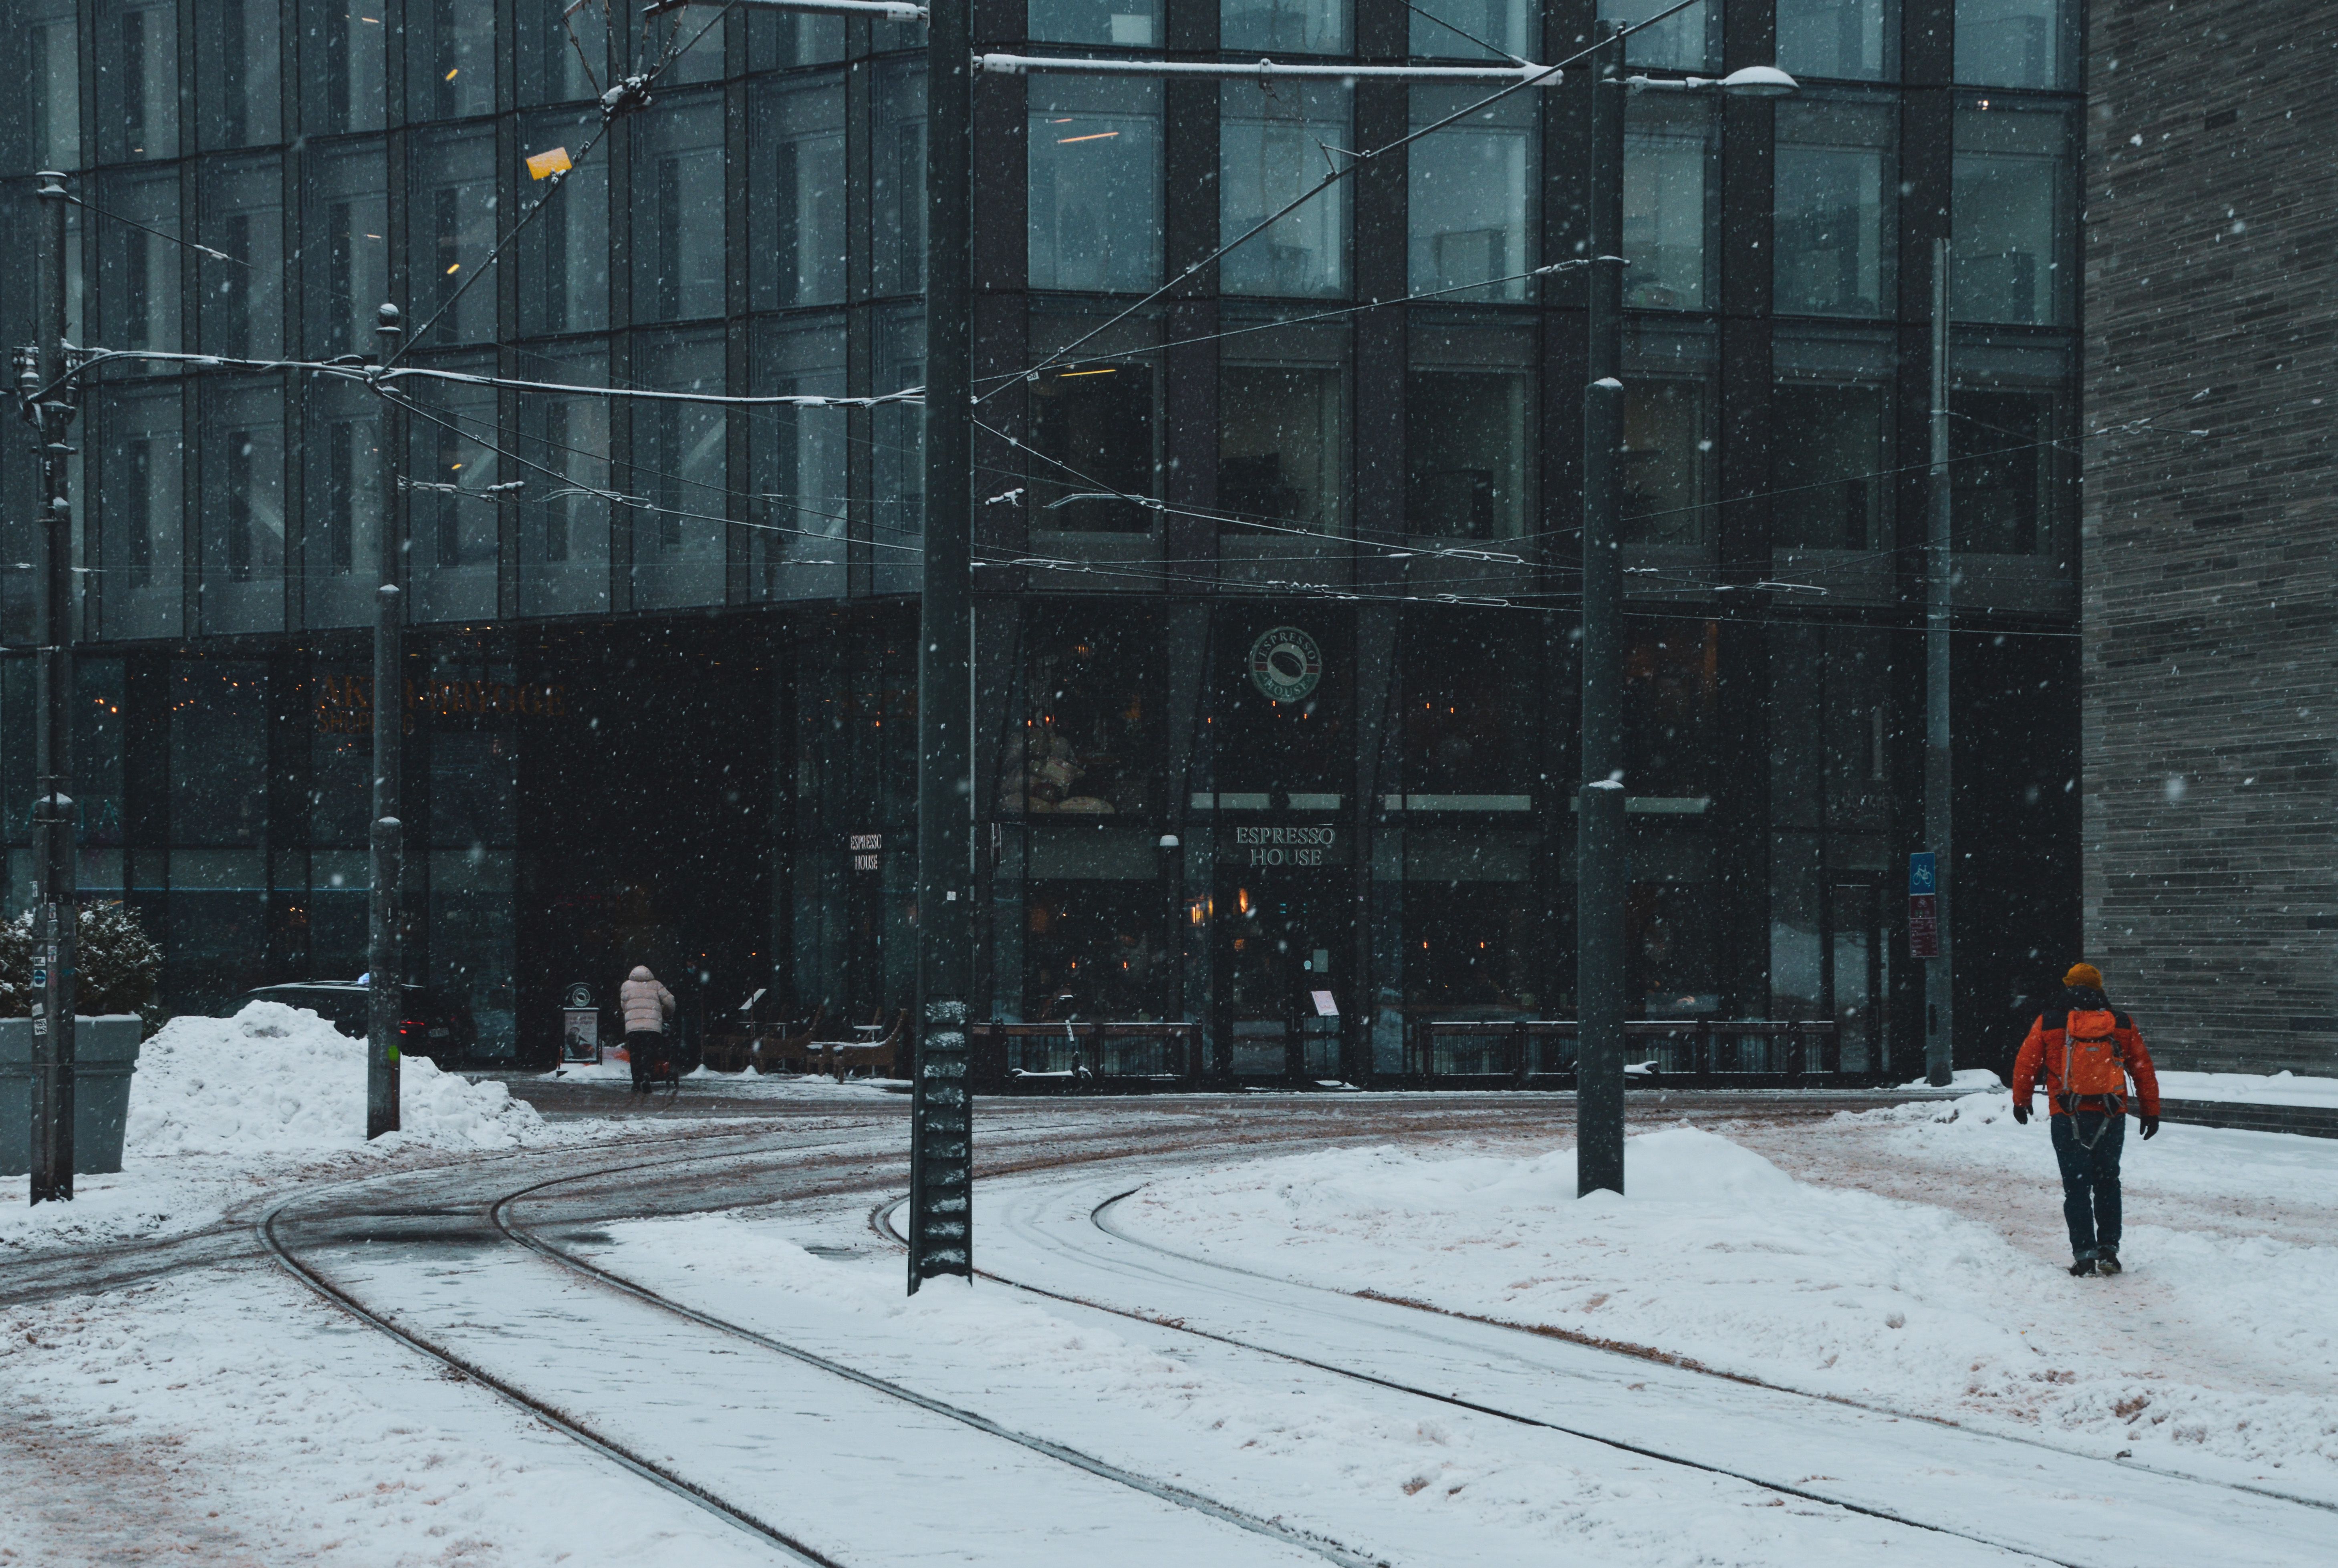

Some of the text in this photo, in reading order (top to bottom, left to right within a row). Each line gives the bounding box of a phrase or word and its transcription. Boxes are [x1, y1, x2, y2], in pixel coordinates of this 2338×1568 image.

[1258, 632, 1316, 660] ESPRESSO
[317, 674, 565, 716] AKR BRYGGE
[1264, 677, 1307, 697] HOUSE
[318, 711, 415, 735] SHOPG
[851, 833, 882, 850] ESPRESSO
[1236, 827, 1336, 845] ESPRESSO
[855, 854, 878, 870] HOUSE
[1250, 848, 1322, 866] HOUSE
